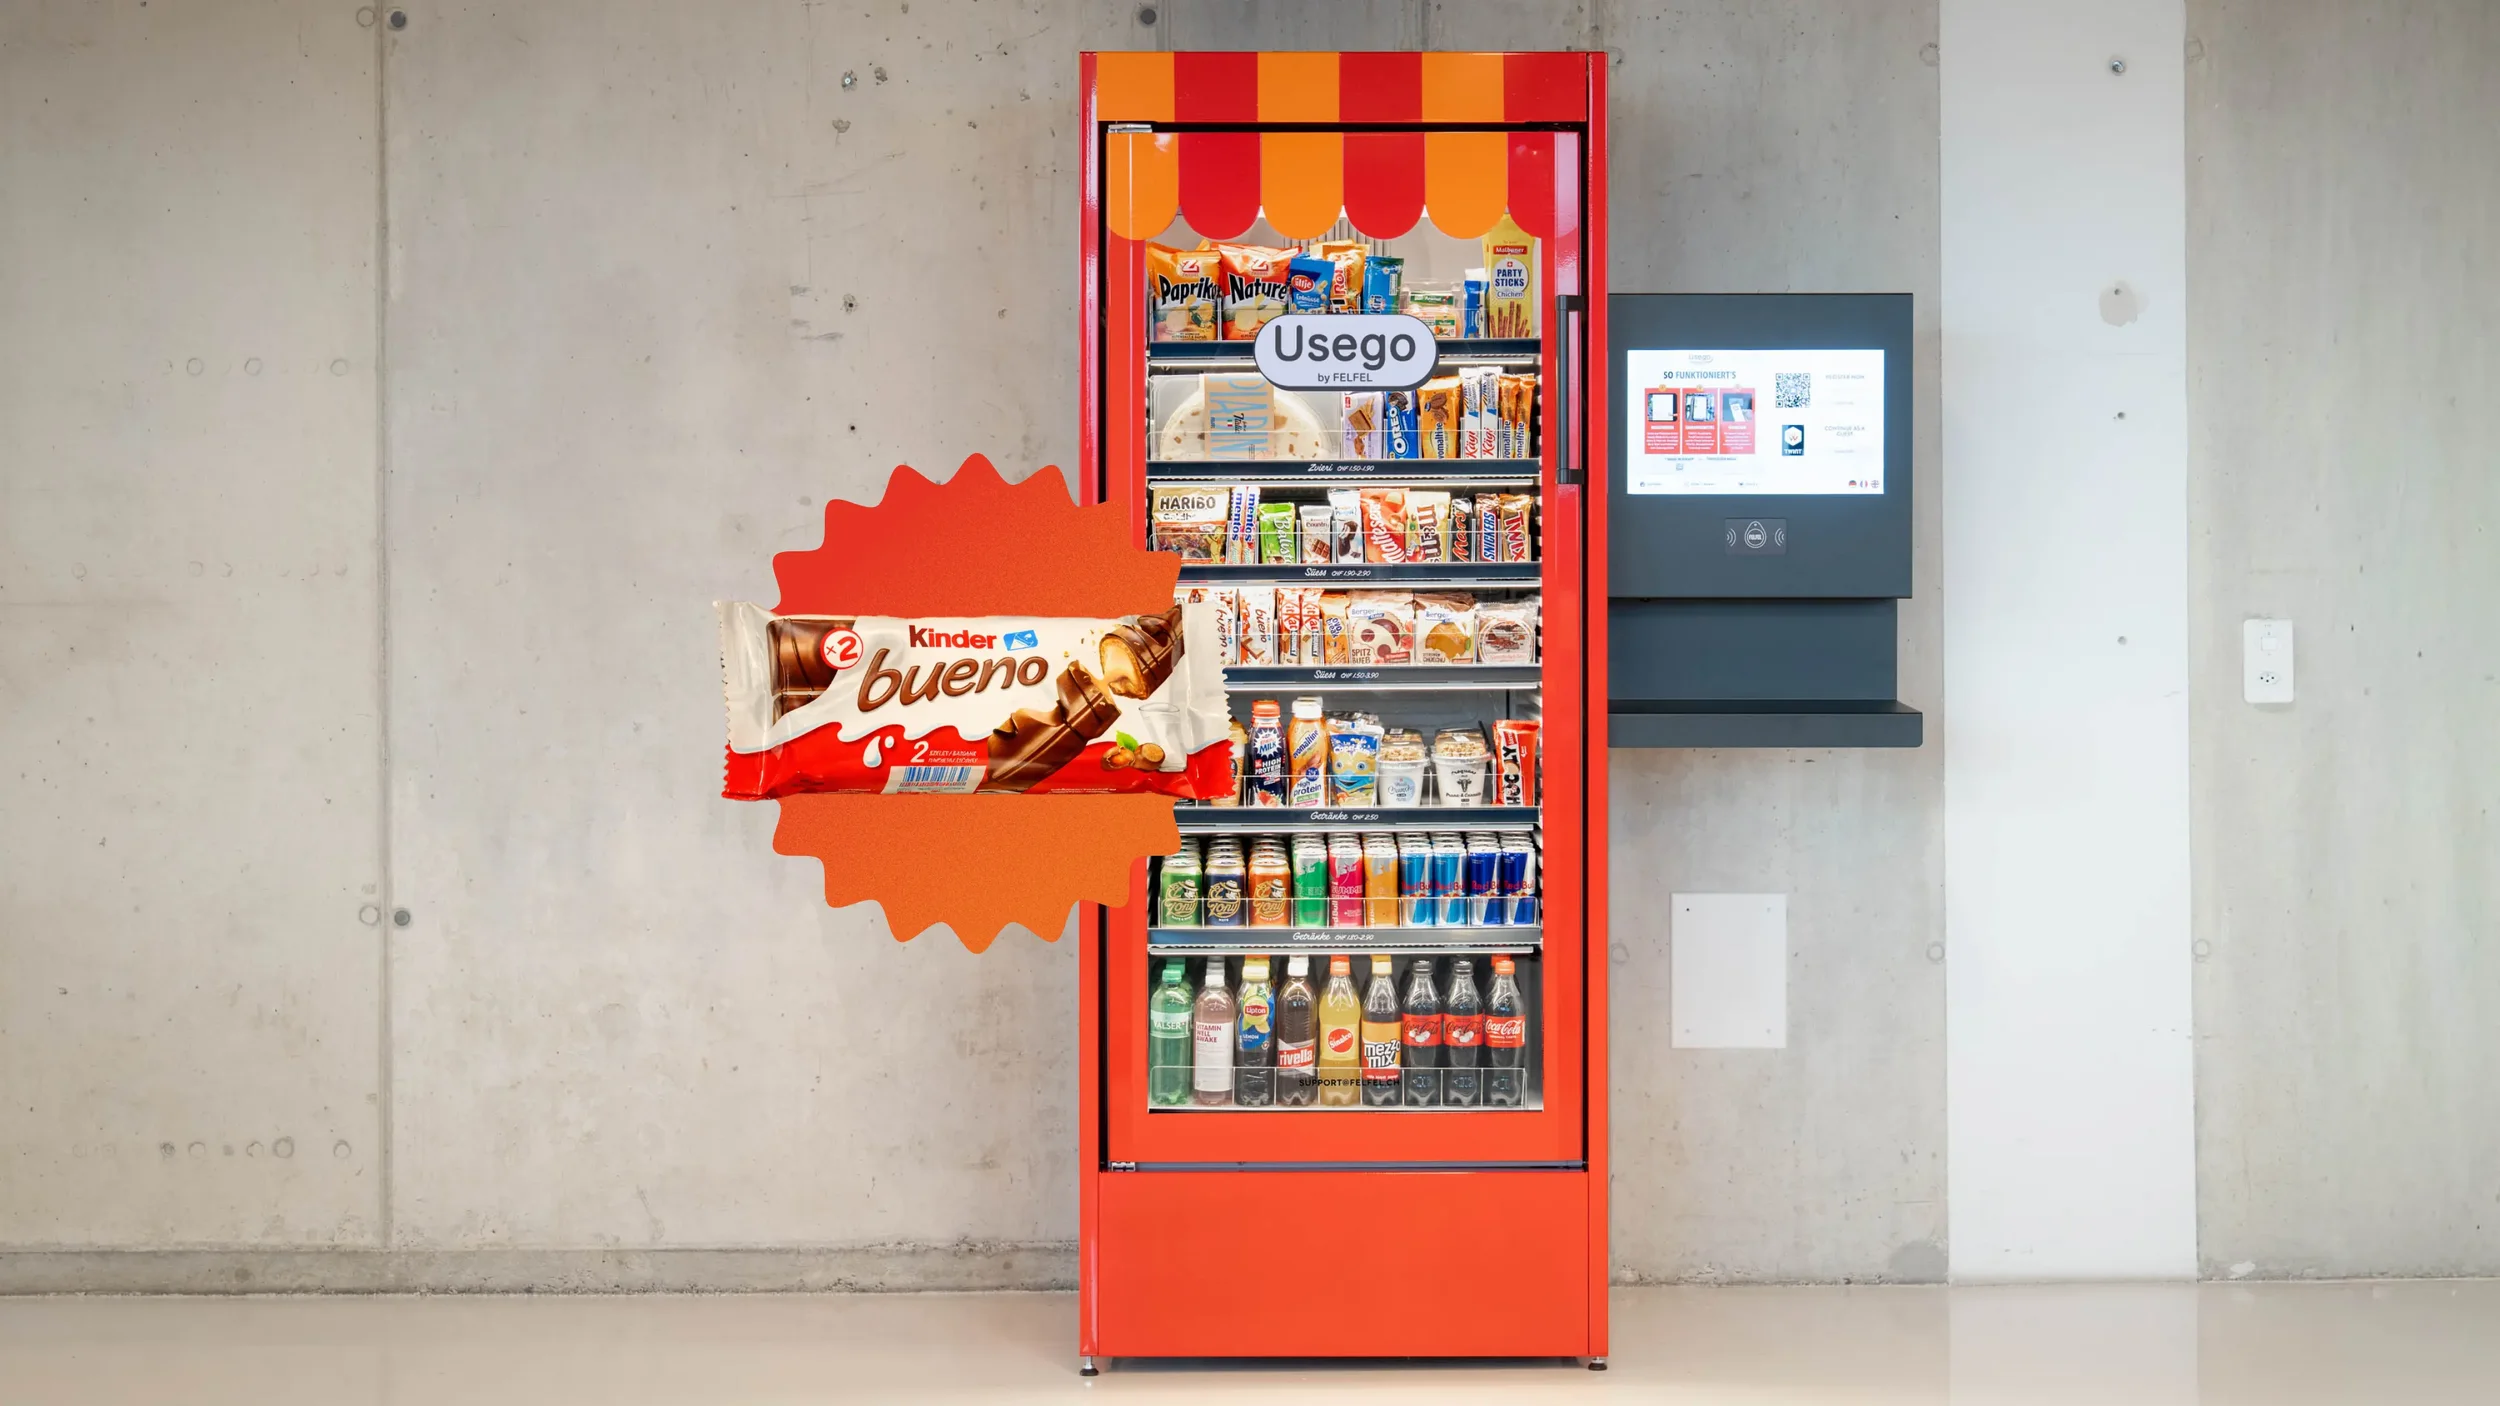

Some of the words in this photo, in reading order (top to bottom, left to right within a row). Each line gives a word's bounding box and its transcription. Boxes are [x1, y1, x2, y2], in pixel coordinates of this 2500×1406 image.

[1497, 269, 1522, 277] PARTY
[1228, 272, 1288, 305] Nature
[1495, 278, 1525, 287] STICKS
[1497, 291, 1524, 299] Chicken
[1275, 324, 1416, 371] Usego
[1317, 373, 1330, 384] by
[1333, 373, 1373, 382] FELFEL
[1663, 371, 1674, 379] SO
[1675, 371, 1737, 379] FUNKTIONIERT'S
[1388, 406, 1407, 455] OREO
[1465, 430, 1479, 459] Kägi
[1482, 427, 1497, 456] Kägi
[1160, 496, 1216, 510] HARIBO
[1231, 492, 1243, 541] mentos
[1245, 493, 1256, 542] mentos
[1452, 511, 1470, 562] Mars
[1483, 511, 1495, 561] SNICKERS
[1505, 510, 1526, 562] TWIX
[1255, 608, 1267, 643] bueno
[909, 624, 998, 649] Kinder
[1351, 649, 1371, 657] SPITZ
[856, 647, 1048, 712] bueno
[910, 740, 929, 763] 2
[1259, 742, 1278, 754] MILK
[1254, 763, 1282, 774] PROTEIN
[1262, 758, 1282, 768] HIGH
[1293, 784, 1322, 797] protein
[1297, 781, 1311, 790] High
[1310, 811, 1349, 821] Getränke
[1471, 880, 1489, 890] Red
[1504, 880, 1520, 890] Red
[1164, 899, 1196, 918] Tony
[1207, 900, 1239, 918] Tony
[1253, 899, 1286, 917] Tony
[1292, 932, 1331, 941] Getränke
[1246, 1007, 1267, 1015] Lipton
[1154, 1020, 1182, 1030] VALSER
[1485, 1018, 1522, 1035] Coca-Cola
[1329, 1032, 1352, 1048] Sinalco
[1364, 1039, 1401, 1057] mezzo
[1279, 1049, 1313, 1066] rivella
[1367, 1051, 1396, 1068] mix
[1299, 1078, 1400, 1087] SUPPORT@FELFEL.CH
